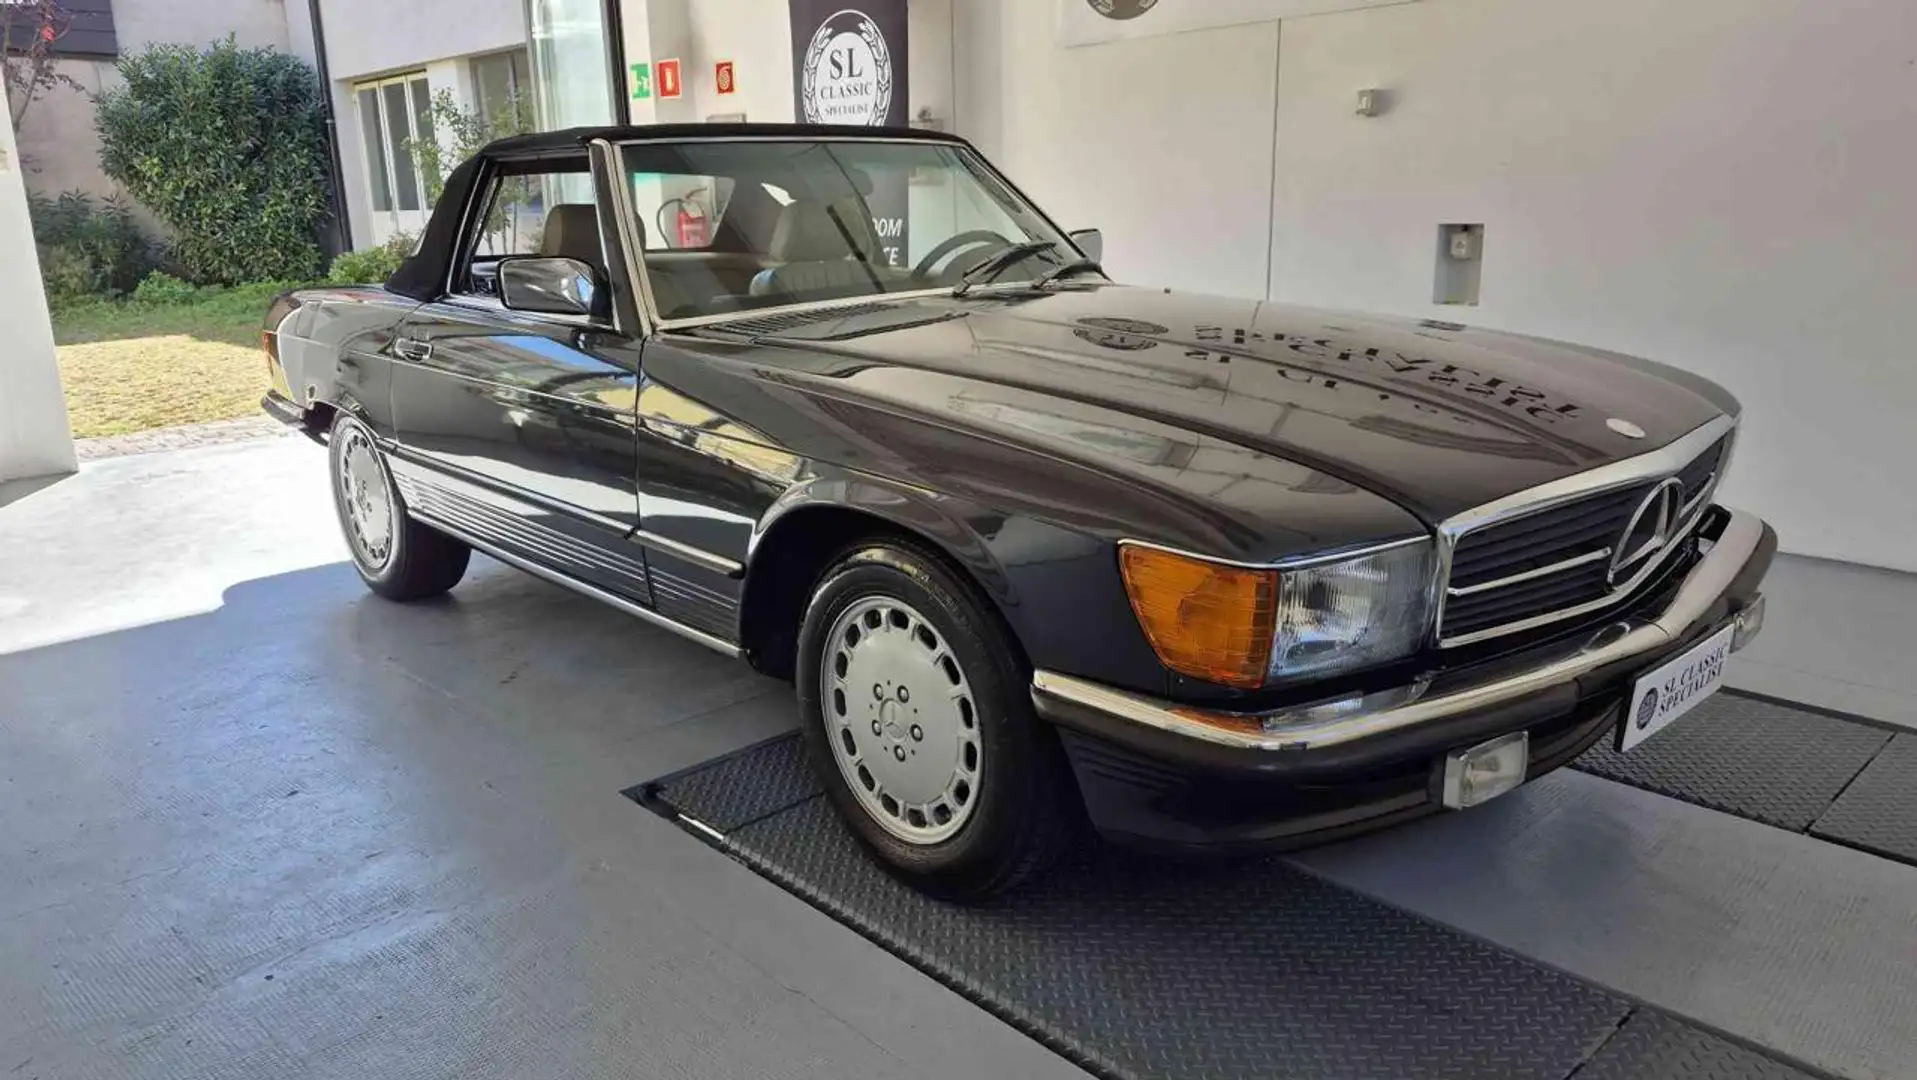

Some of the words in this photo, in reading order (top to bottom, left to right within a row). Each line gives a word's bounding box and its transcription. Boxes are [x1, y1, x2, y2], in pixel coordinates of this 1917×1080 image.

[830, 48, 863, 80] SL
[820, 81, 873, 100] CLASSIC
[1658, 660, 1724, 716] SPECIALIST
[1661, 674, 1678, 697] SL
[1680, 647, 1724, 686] CLASSIC
